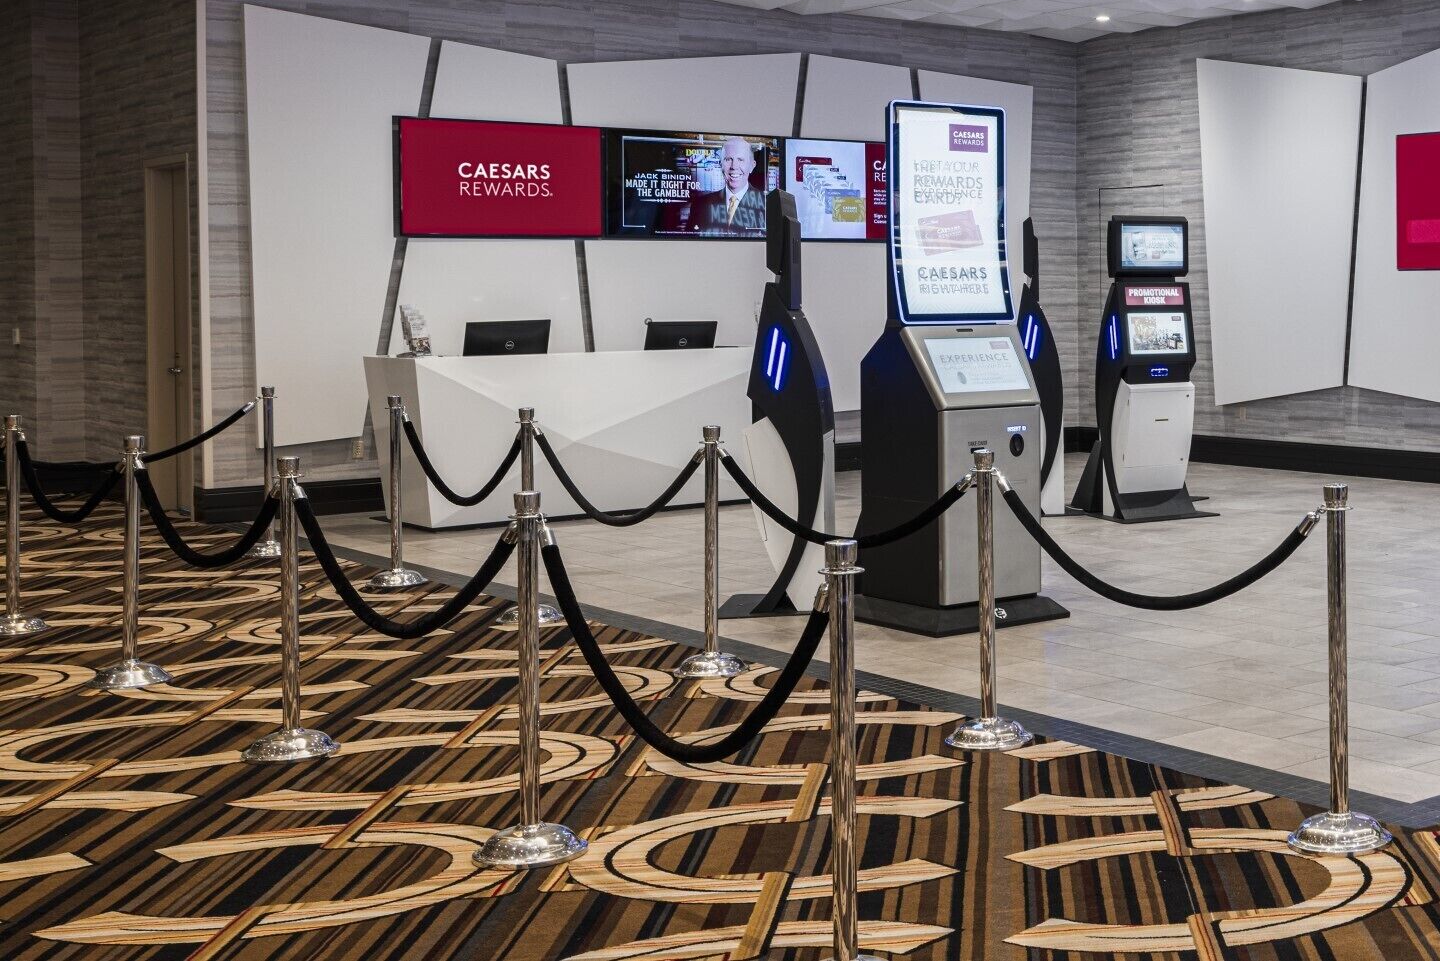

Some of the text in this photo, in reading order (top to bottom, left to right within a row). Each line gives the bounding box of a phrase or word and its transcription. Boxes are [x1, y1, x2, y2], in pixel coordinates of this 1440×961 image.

[953, 130, 985, 139] CAESARS
[953, 138, 985, 147] REWARDS
[458, 162, 551, 180] CAESARS
[662, 173, 692, 181] BINION
[625, 179, 701, 190] MADE IT RIGHT FOR
[637, 188, 690, 198] THE GAMBLER
[918, 266, 988, 279] CAESARS
[1128, 288, 1180, 297] PROMOTIONAL
[1143, 296, 1166, 304] KIOSK
[939, 352, 1009, 364] EXPERIENCE
